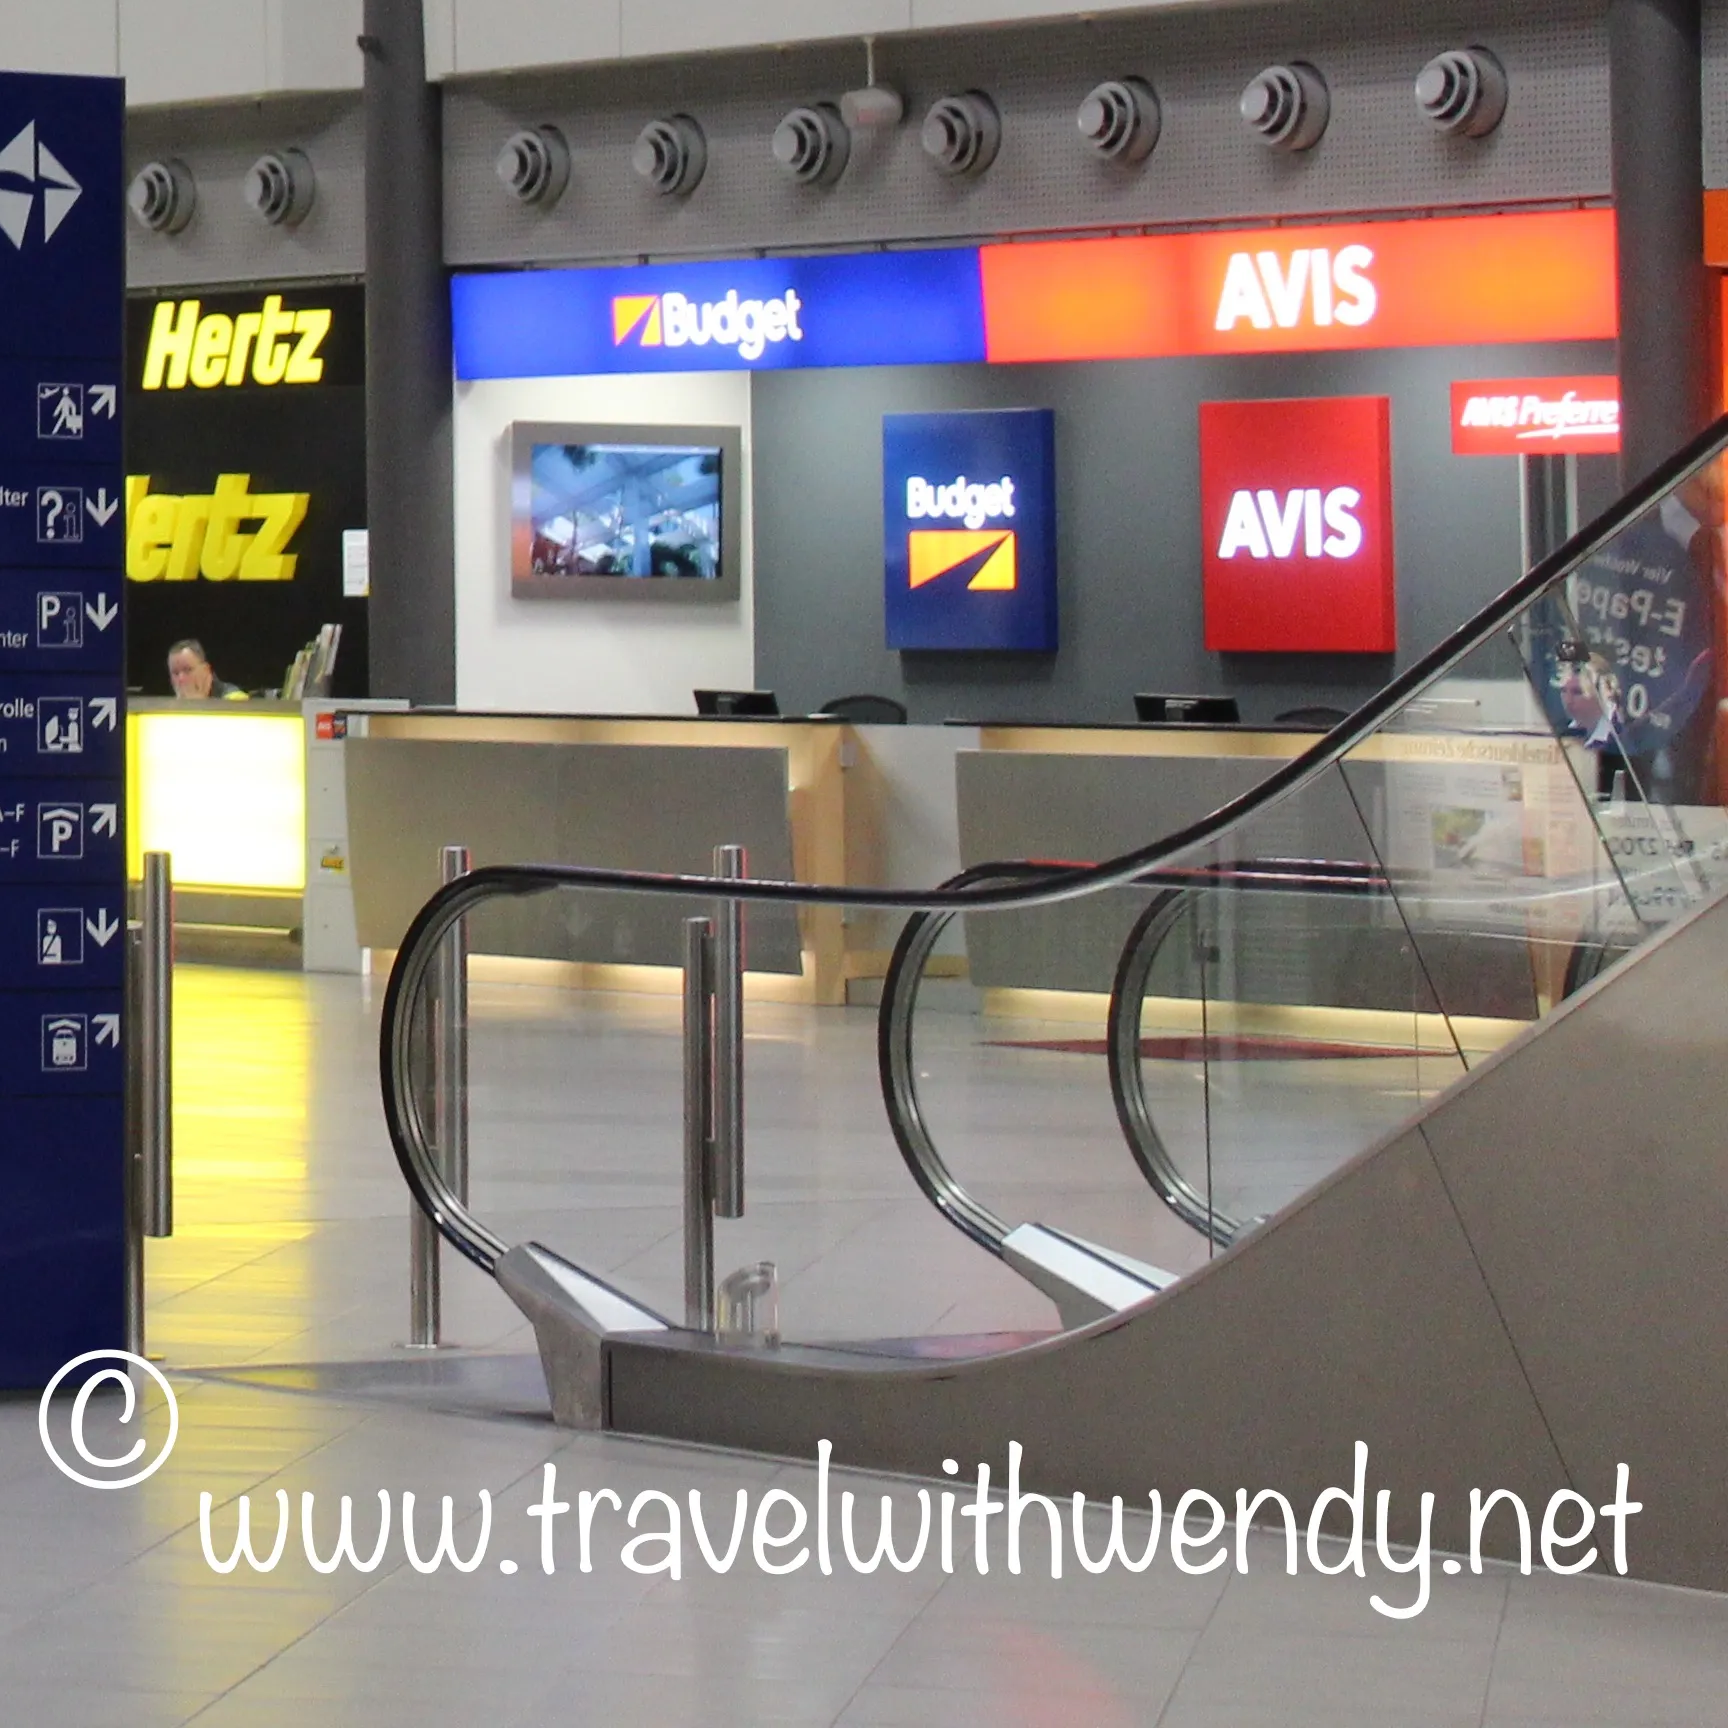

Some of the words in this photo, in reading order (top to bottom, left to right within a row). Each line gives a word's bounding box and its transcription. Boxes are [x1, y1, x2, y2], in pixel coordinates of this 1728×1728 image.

[1214, 244, 1377, 331] AVIS
[141, 294, 332, 390] Hertz
[661, 289, 803, 360] Budget
[1461, 395, 1519, 427] AVIS
[1518, 390, 1619, 439] Preferre
[905, 475, 1016, 530] Budget
[1217, 486, 1363, 559] AVIS
